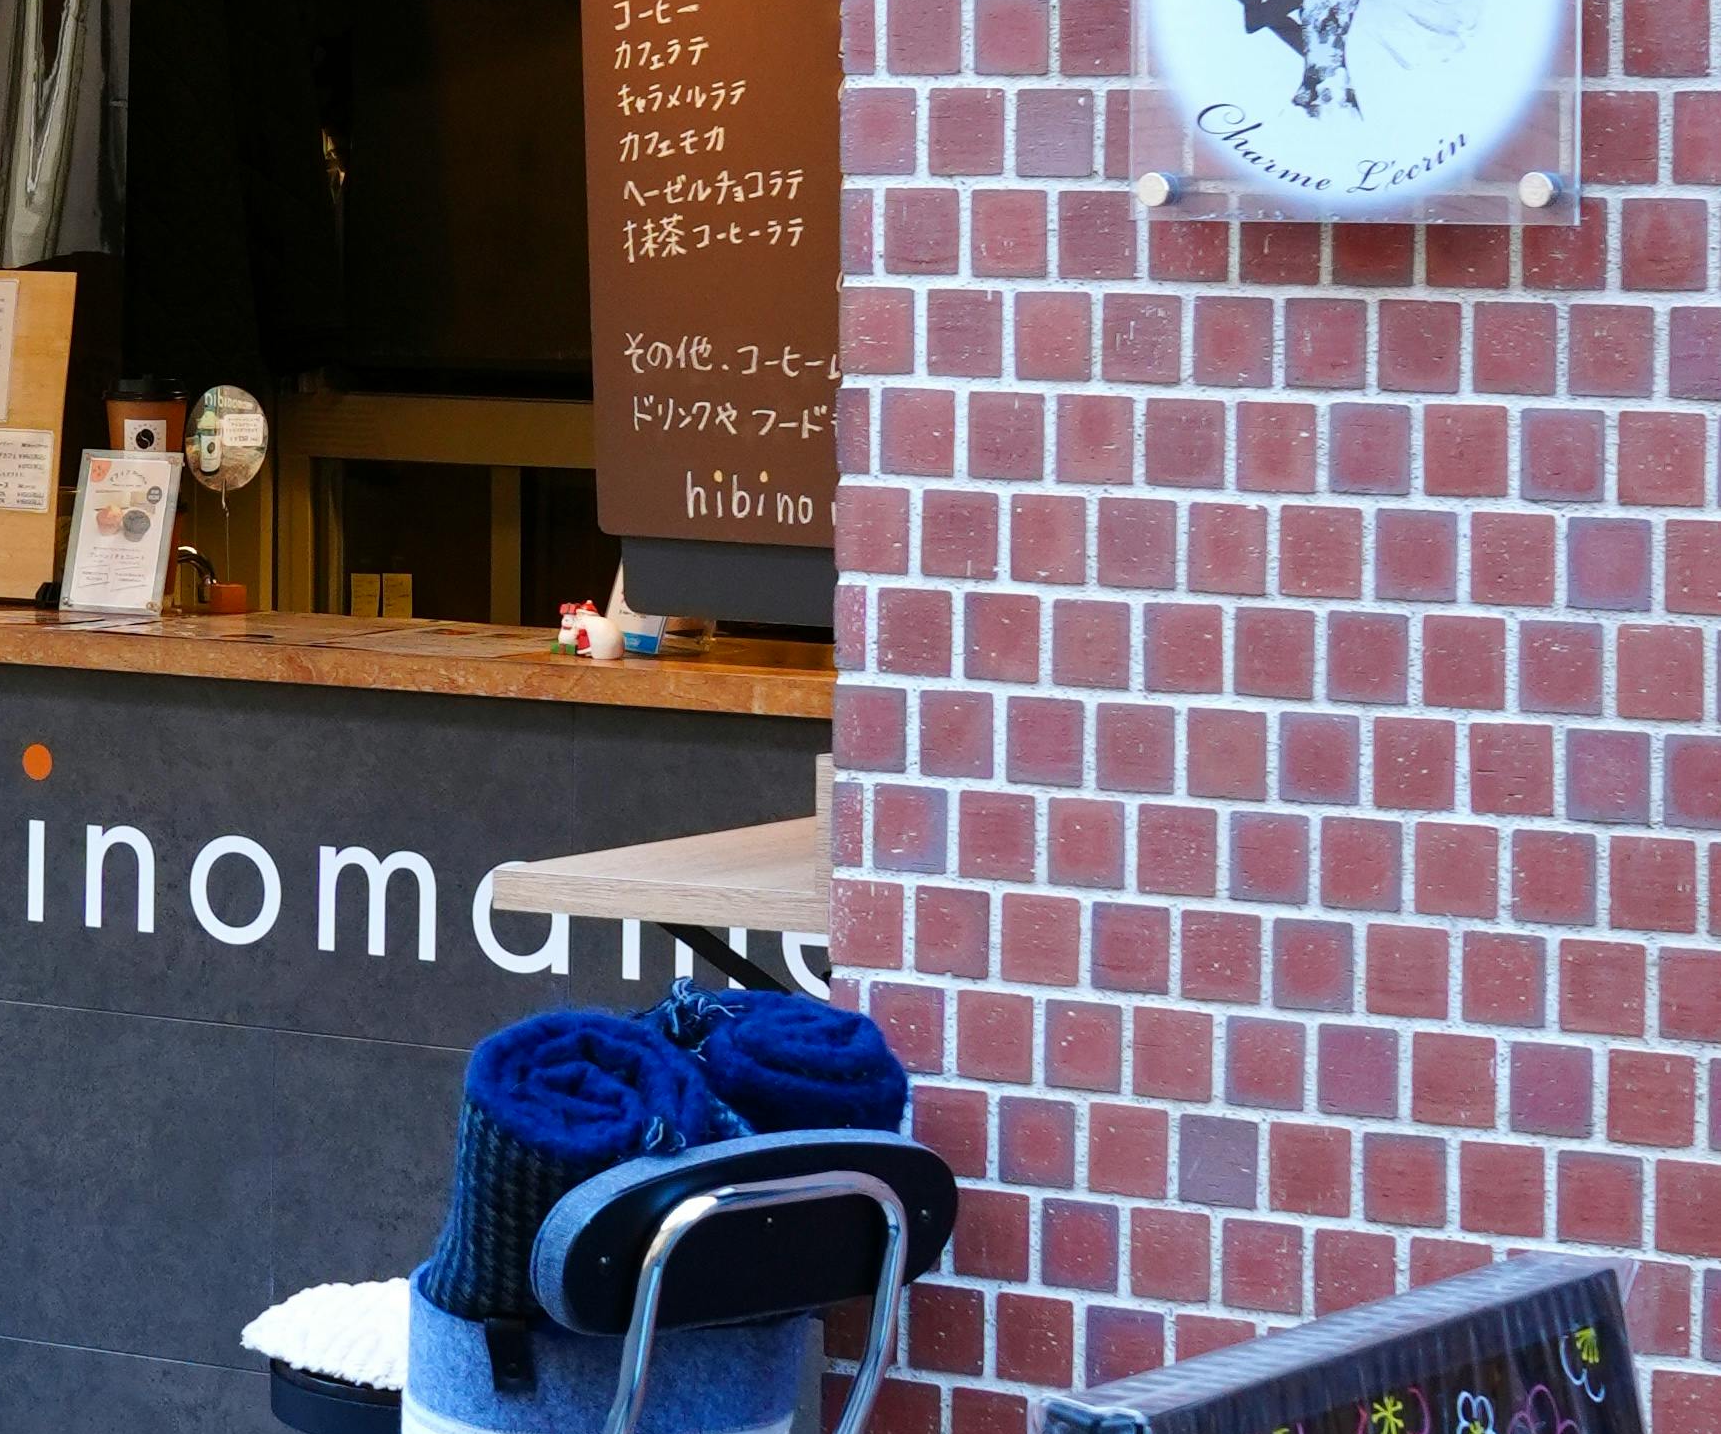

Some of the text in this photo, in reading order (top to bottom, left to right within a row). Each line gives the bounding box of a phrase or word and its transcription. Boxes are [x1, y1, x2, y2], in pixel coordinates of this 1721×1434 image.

[614, 35, 710, 70] カフェラテ
[617, 80, 748, 117] キャラメルラテ
[619, 126, 725, 163] カフェモカ
[1196, 103, 1331, 192] Charme
[623, 169, 805, 208] ヘーゼルチョコラテ
[623, 214, 805, 264] 抹茶コーヒーラテ
[632, 395, 837, 440] ドリンクやフード
[686, 469, 813, 525] hibino
